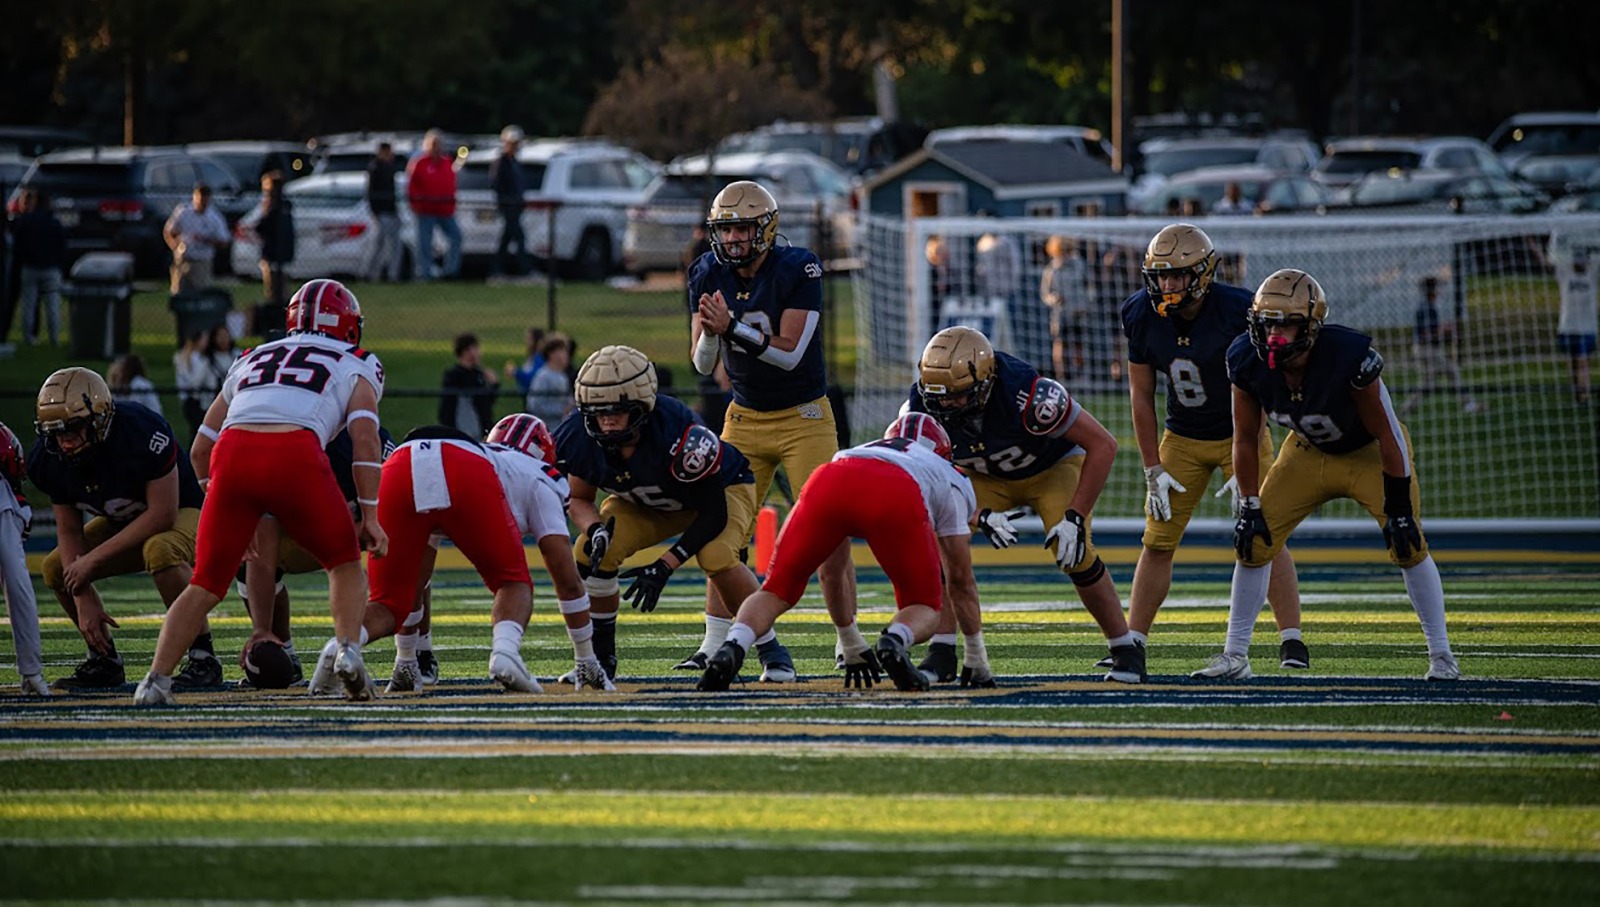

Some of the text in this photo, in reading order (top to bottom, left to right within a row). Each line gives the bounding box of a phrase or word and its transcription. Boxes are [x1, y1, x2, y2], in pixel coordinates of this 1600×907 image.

[238, 345, 344, 394] 35
[1170, 358, 1207, 407] 8
[1040, 386, 1061, 418] TAG
[149, 431, 170, 455] SU
[420, 441, 431, 450] 2
[687, 436, 713, 468] TAG
